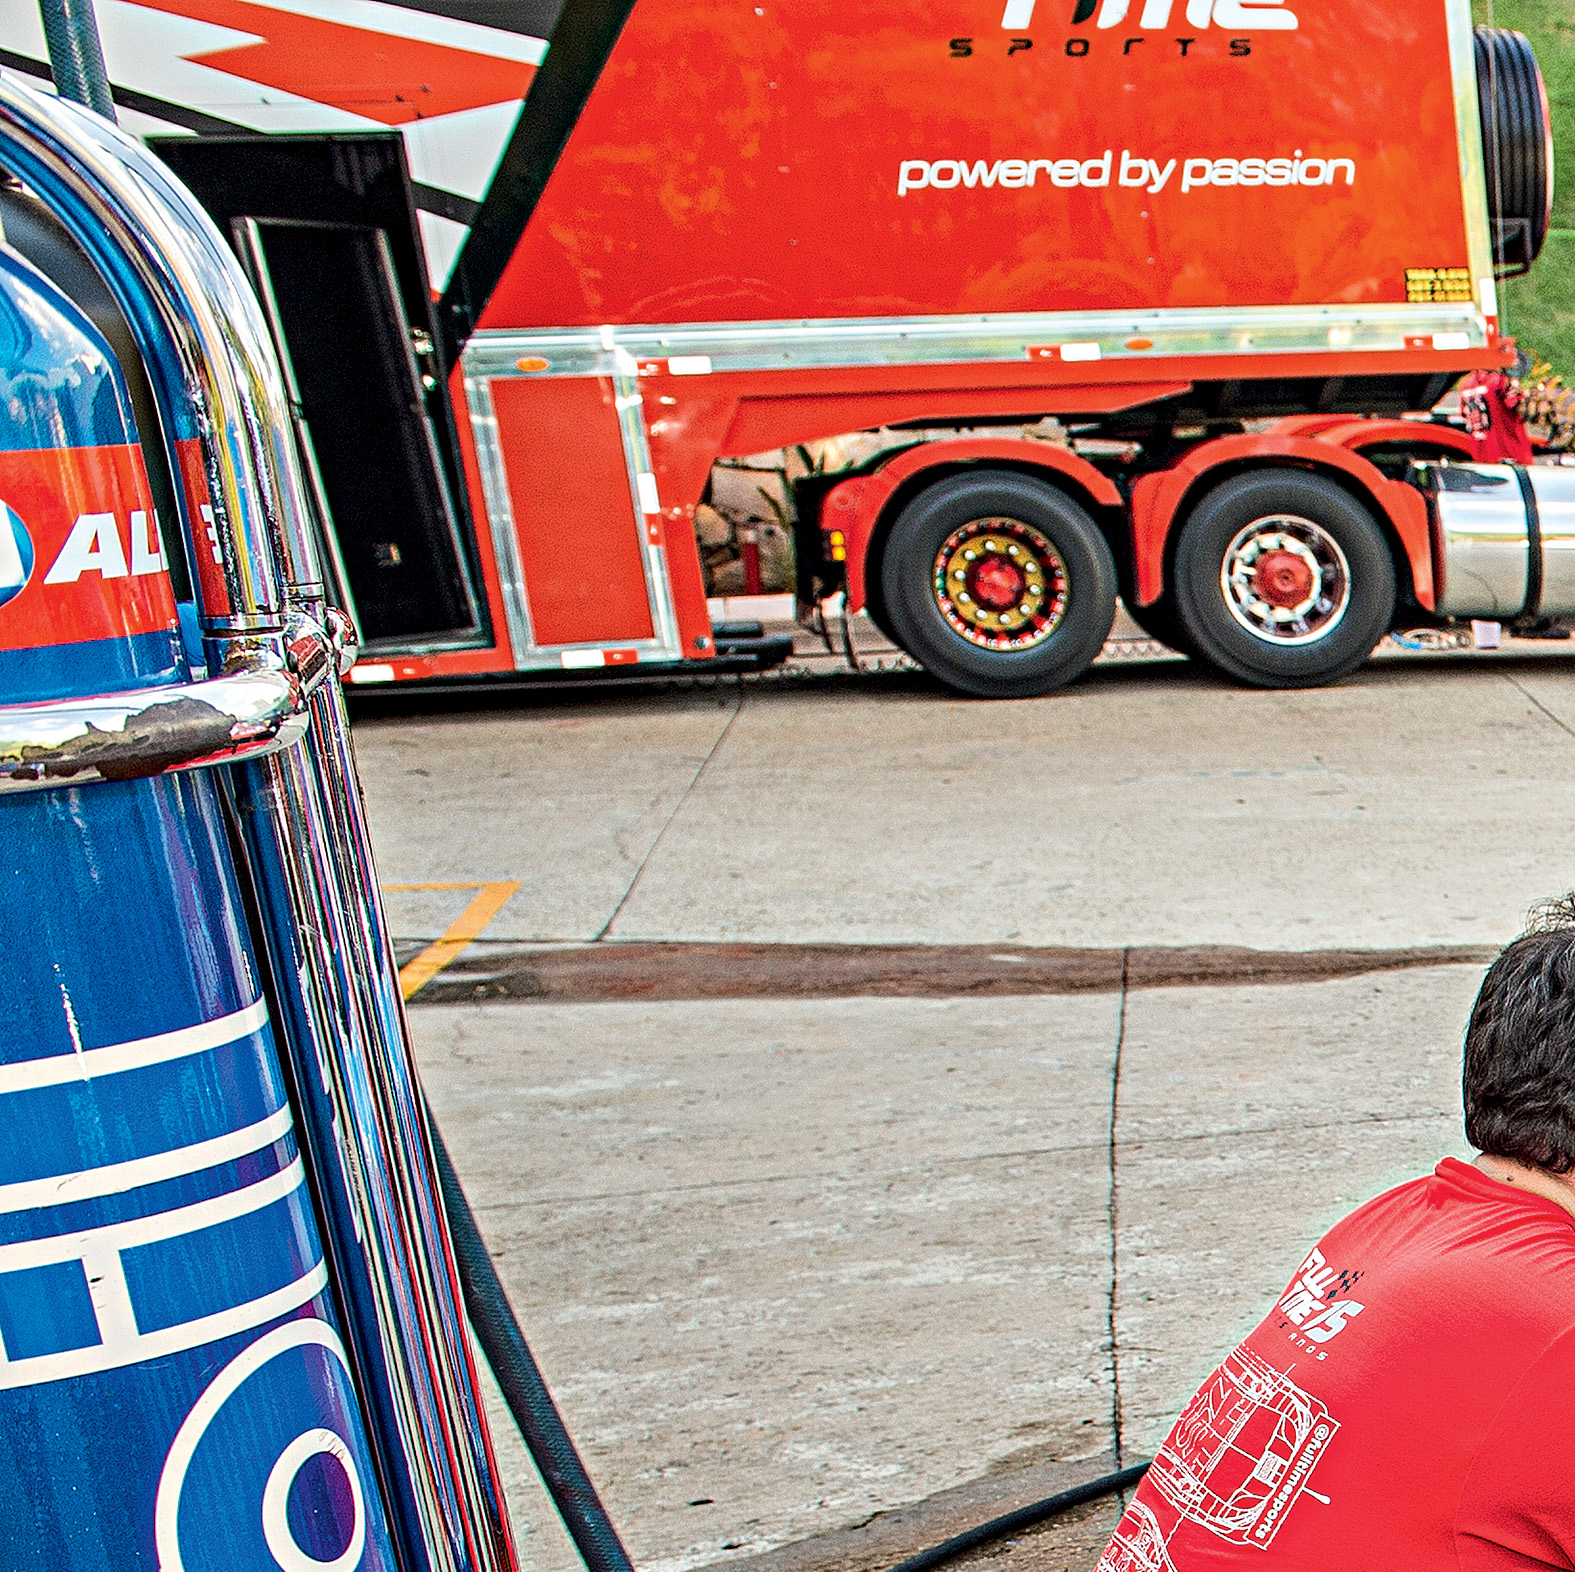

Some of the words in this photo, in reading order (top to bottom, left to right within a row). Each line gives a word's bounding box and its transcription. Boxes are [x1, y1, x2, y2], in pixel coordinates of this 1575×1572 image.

[898, 150, 1112, 195] powered
[1119, 150, 1176, 193] by
[1182, 150, 1355, 193] passion
[1255, 1423, 1330, 1540] @fulltimesports
